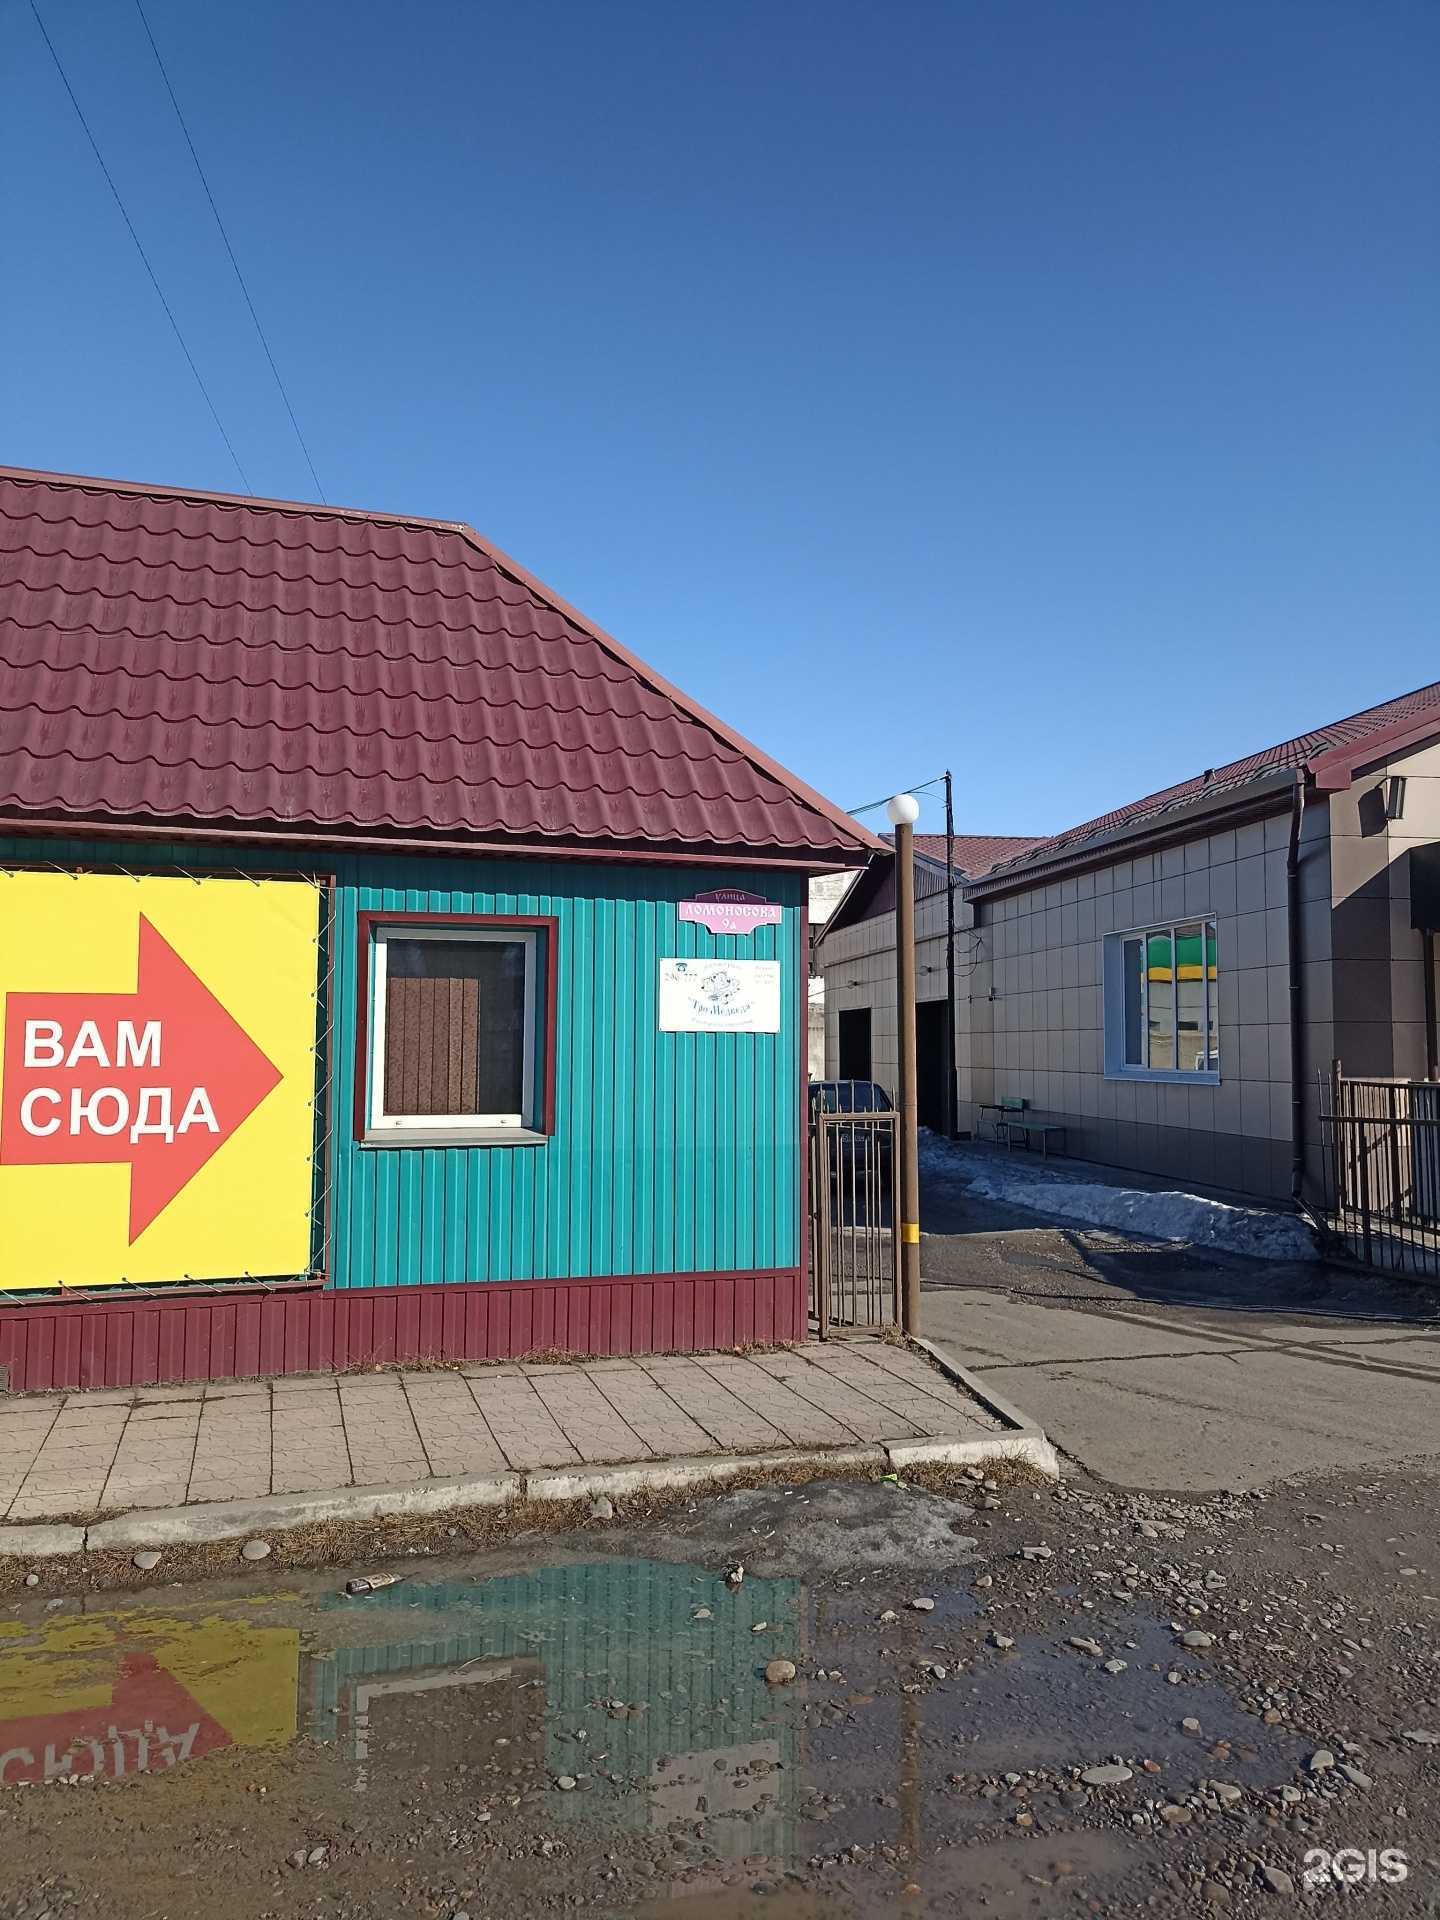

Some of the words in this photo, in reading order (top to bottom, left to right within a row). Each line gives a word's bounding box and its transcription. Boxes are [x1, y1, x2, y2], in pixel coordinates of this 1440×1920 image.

[685, 904, 776, 918] ЛОМОНОСОВА
[23, 1019, 162, 1069] ВАМ
[19, 1086, 221, 1144] СЮДА
